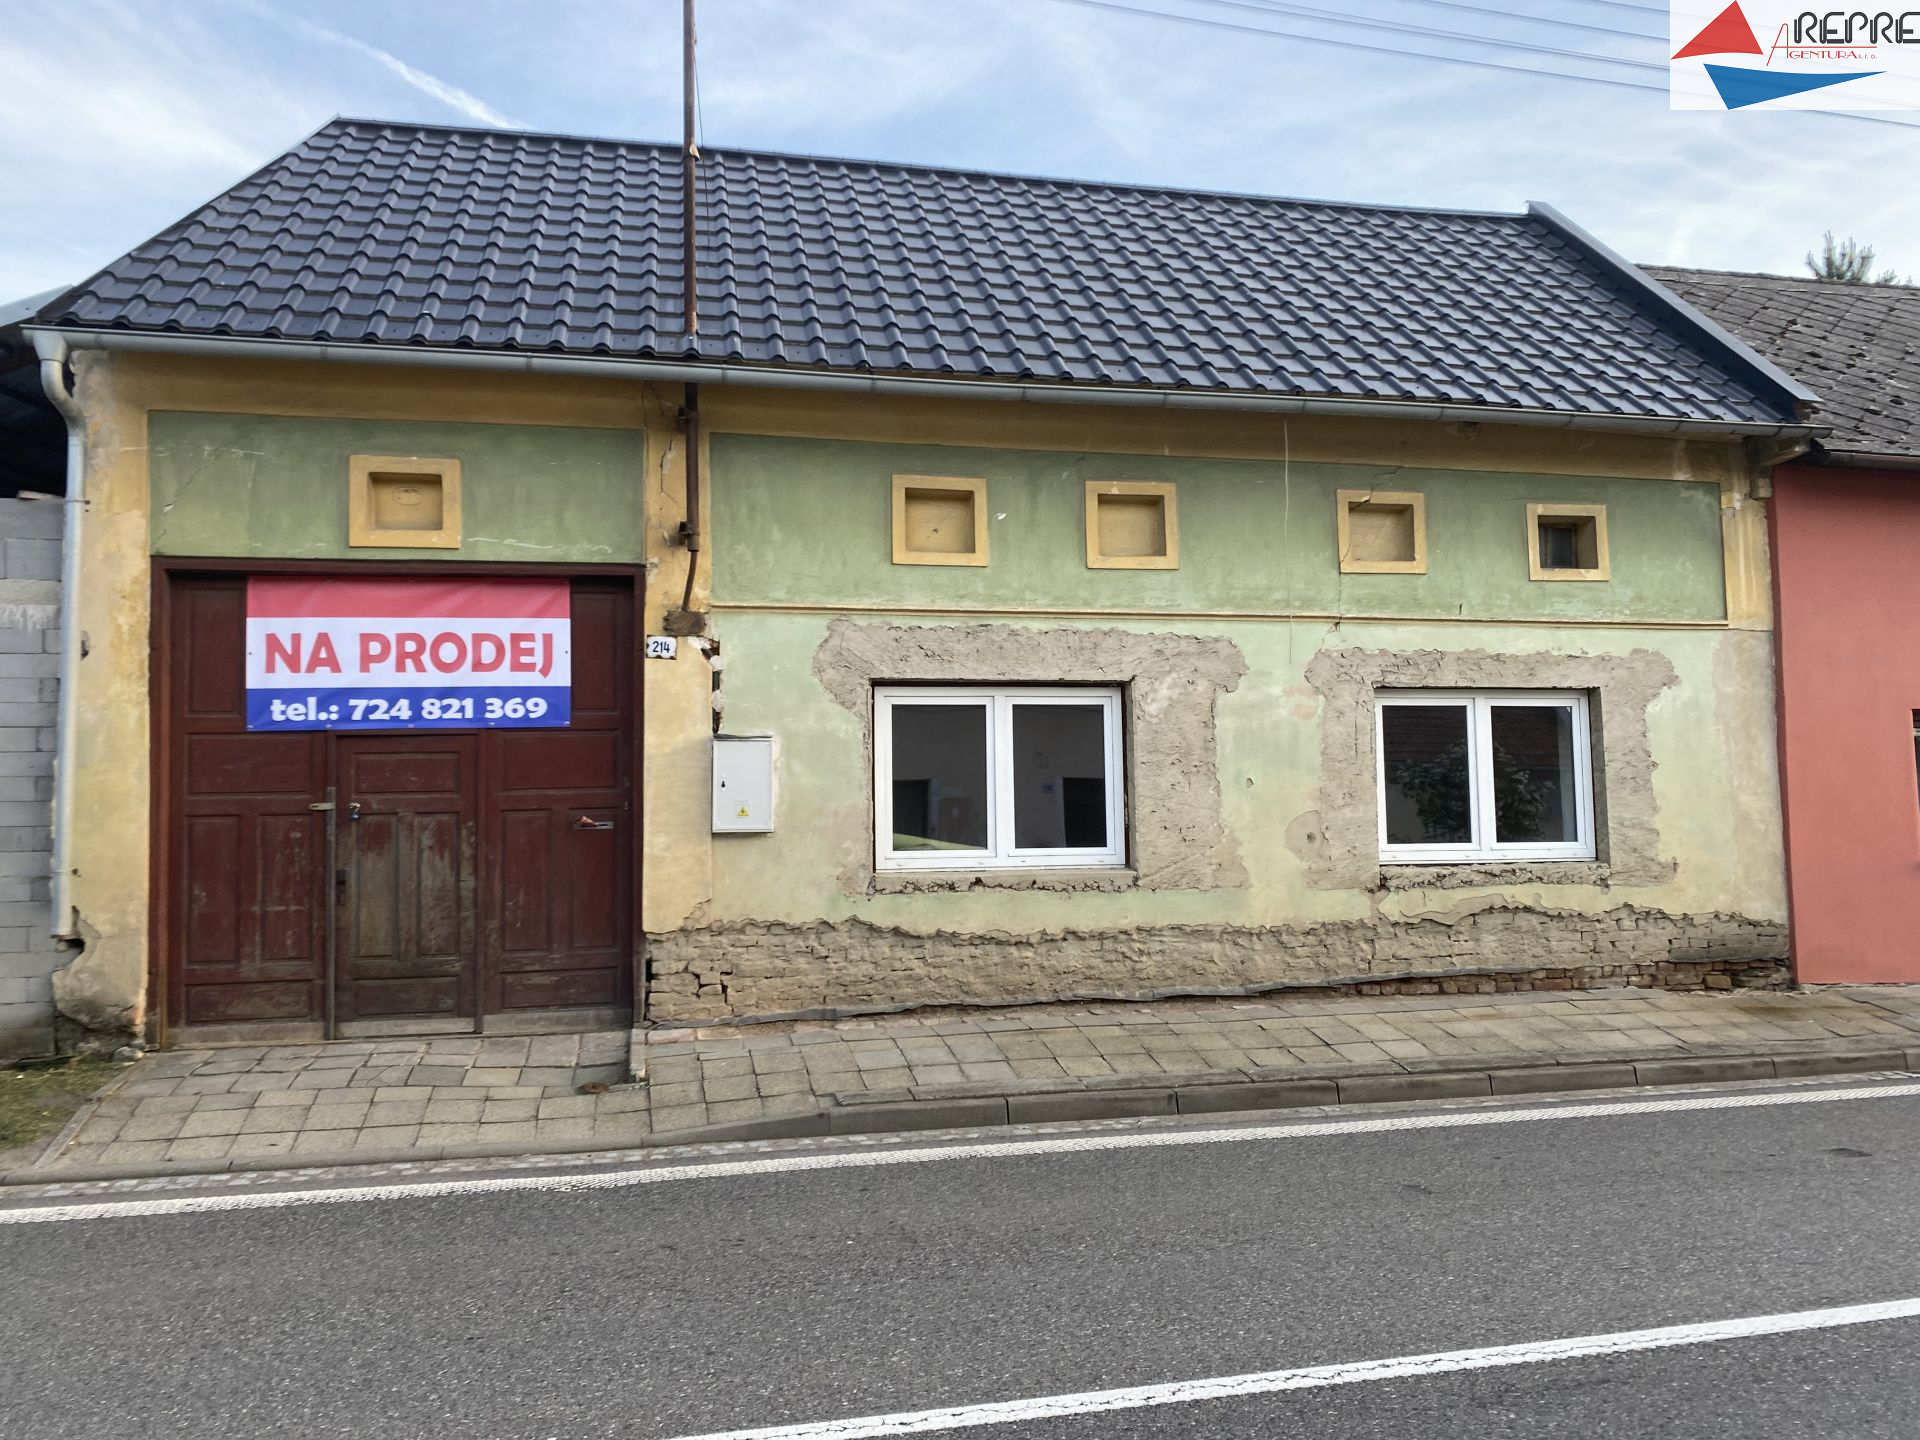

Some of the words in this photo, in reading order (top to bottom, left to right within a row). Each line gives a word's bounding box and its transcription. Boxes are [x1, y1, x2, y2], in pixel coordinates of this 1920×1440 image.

[265, 632, 342, 673] NA
[359, 631, 553, 678] PRODEJ
[652, 640, 670, 653] 214
[270, 697, 338, 721] tel.:
[349, 699, 412, 720] 724
[421, 697, 476, 719] 821
[484, 697, 547, 718] 369
